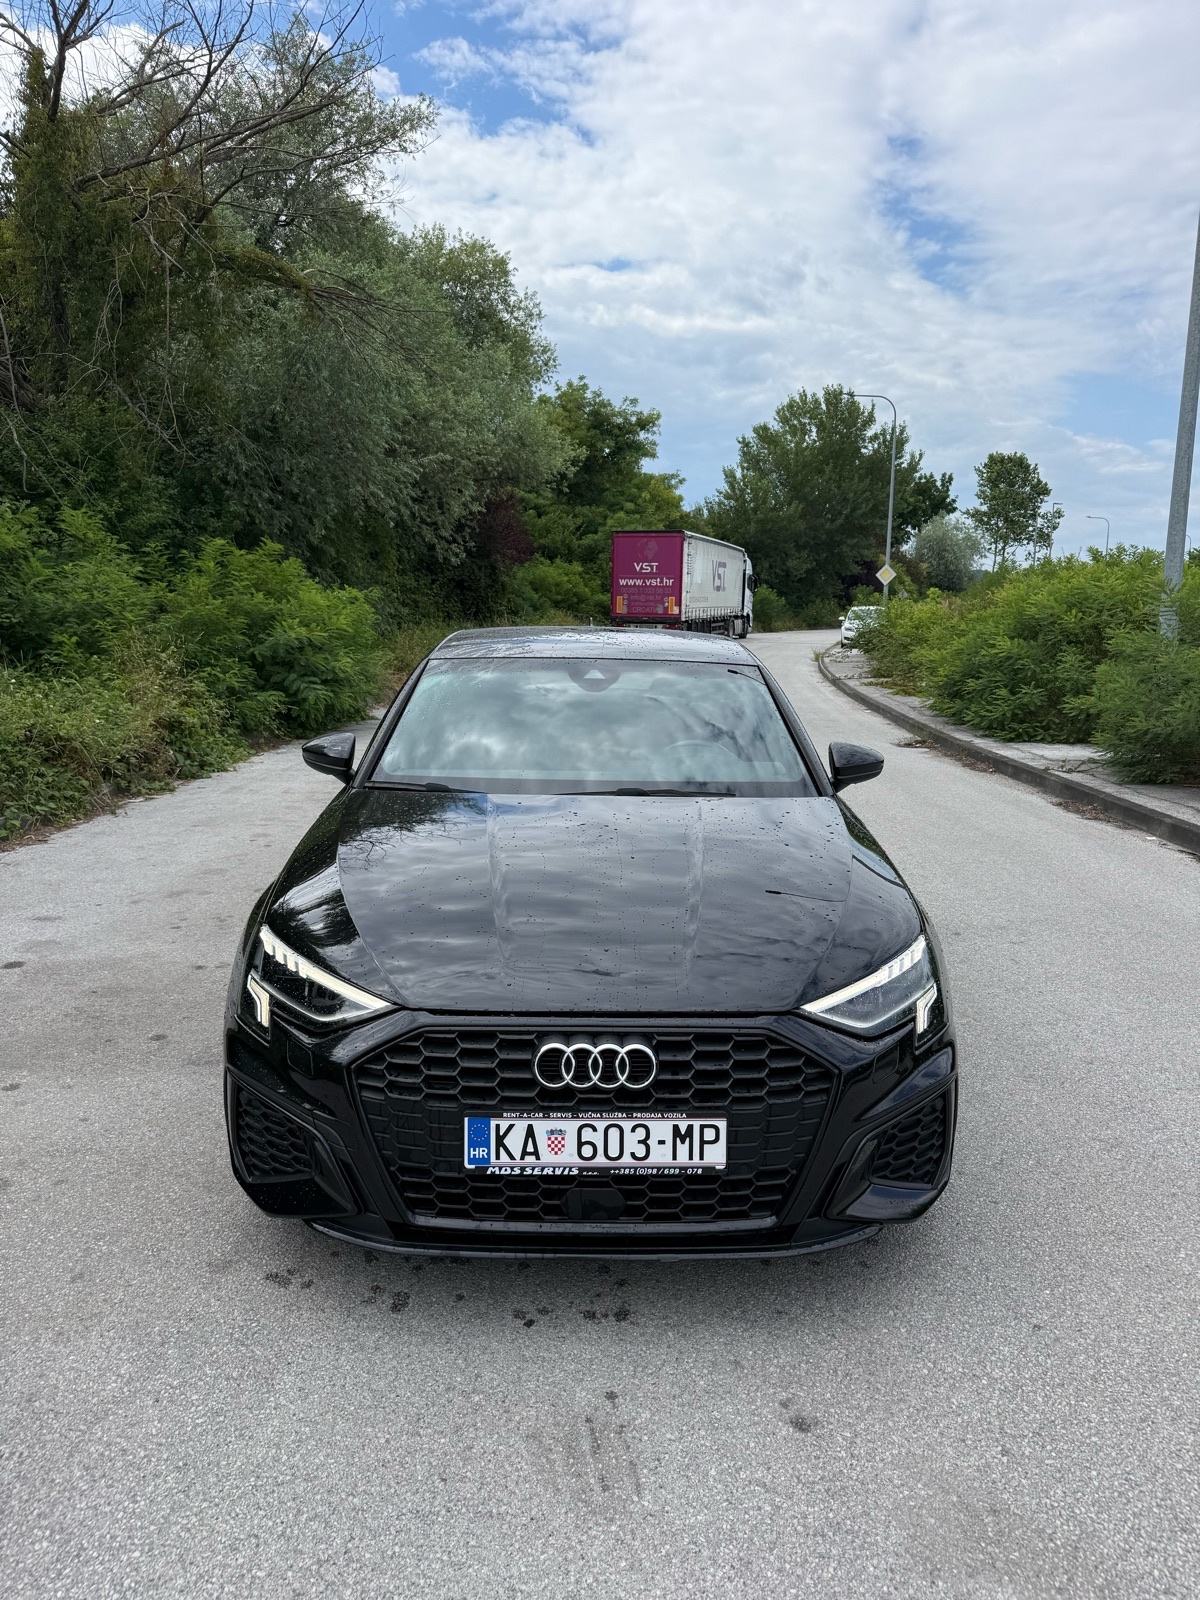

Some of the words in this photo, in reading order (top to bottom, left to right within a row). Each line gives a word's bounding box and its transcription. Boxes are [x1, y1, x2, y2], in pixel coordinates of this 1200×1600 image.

[634, 562, 659, 573] VST
[711, 560, 727, 592] VST
[618, 577, 674, 587] www.vst.hr
[578, 1111, 601, 1119] VUČNA
[602, 1111, 627, 1119] SLUŽBA
[496, 1123, 540, 1161] KA
[469, 1147, 488, 1159] HR
[487, 1167, 522, 1175] MDS
[524, 1167, 580, 1175] SERVIS
